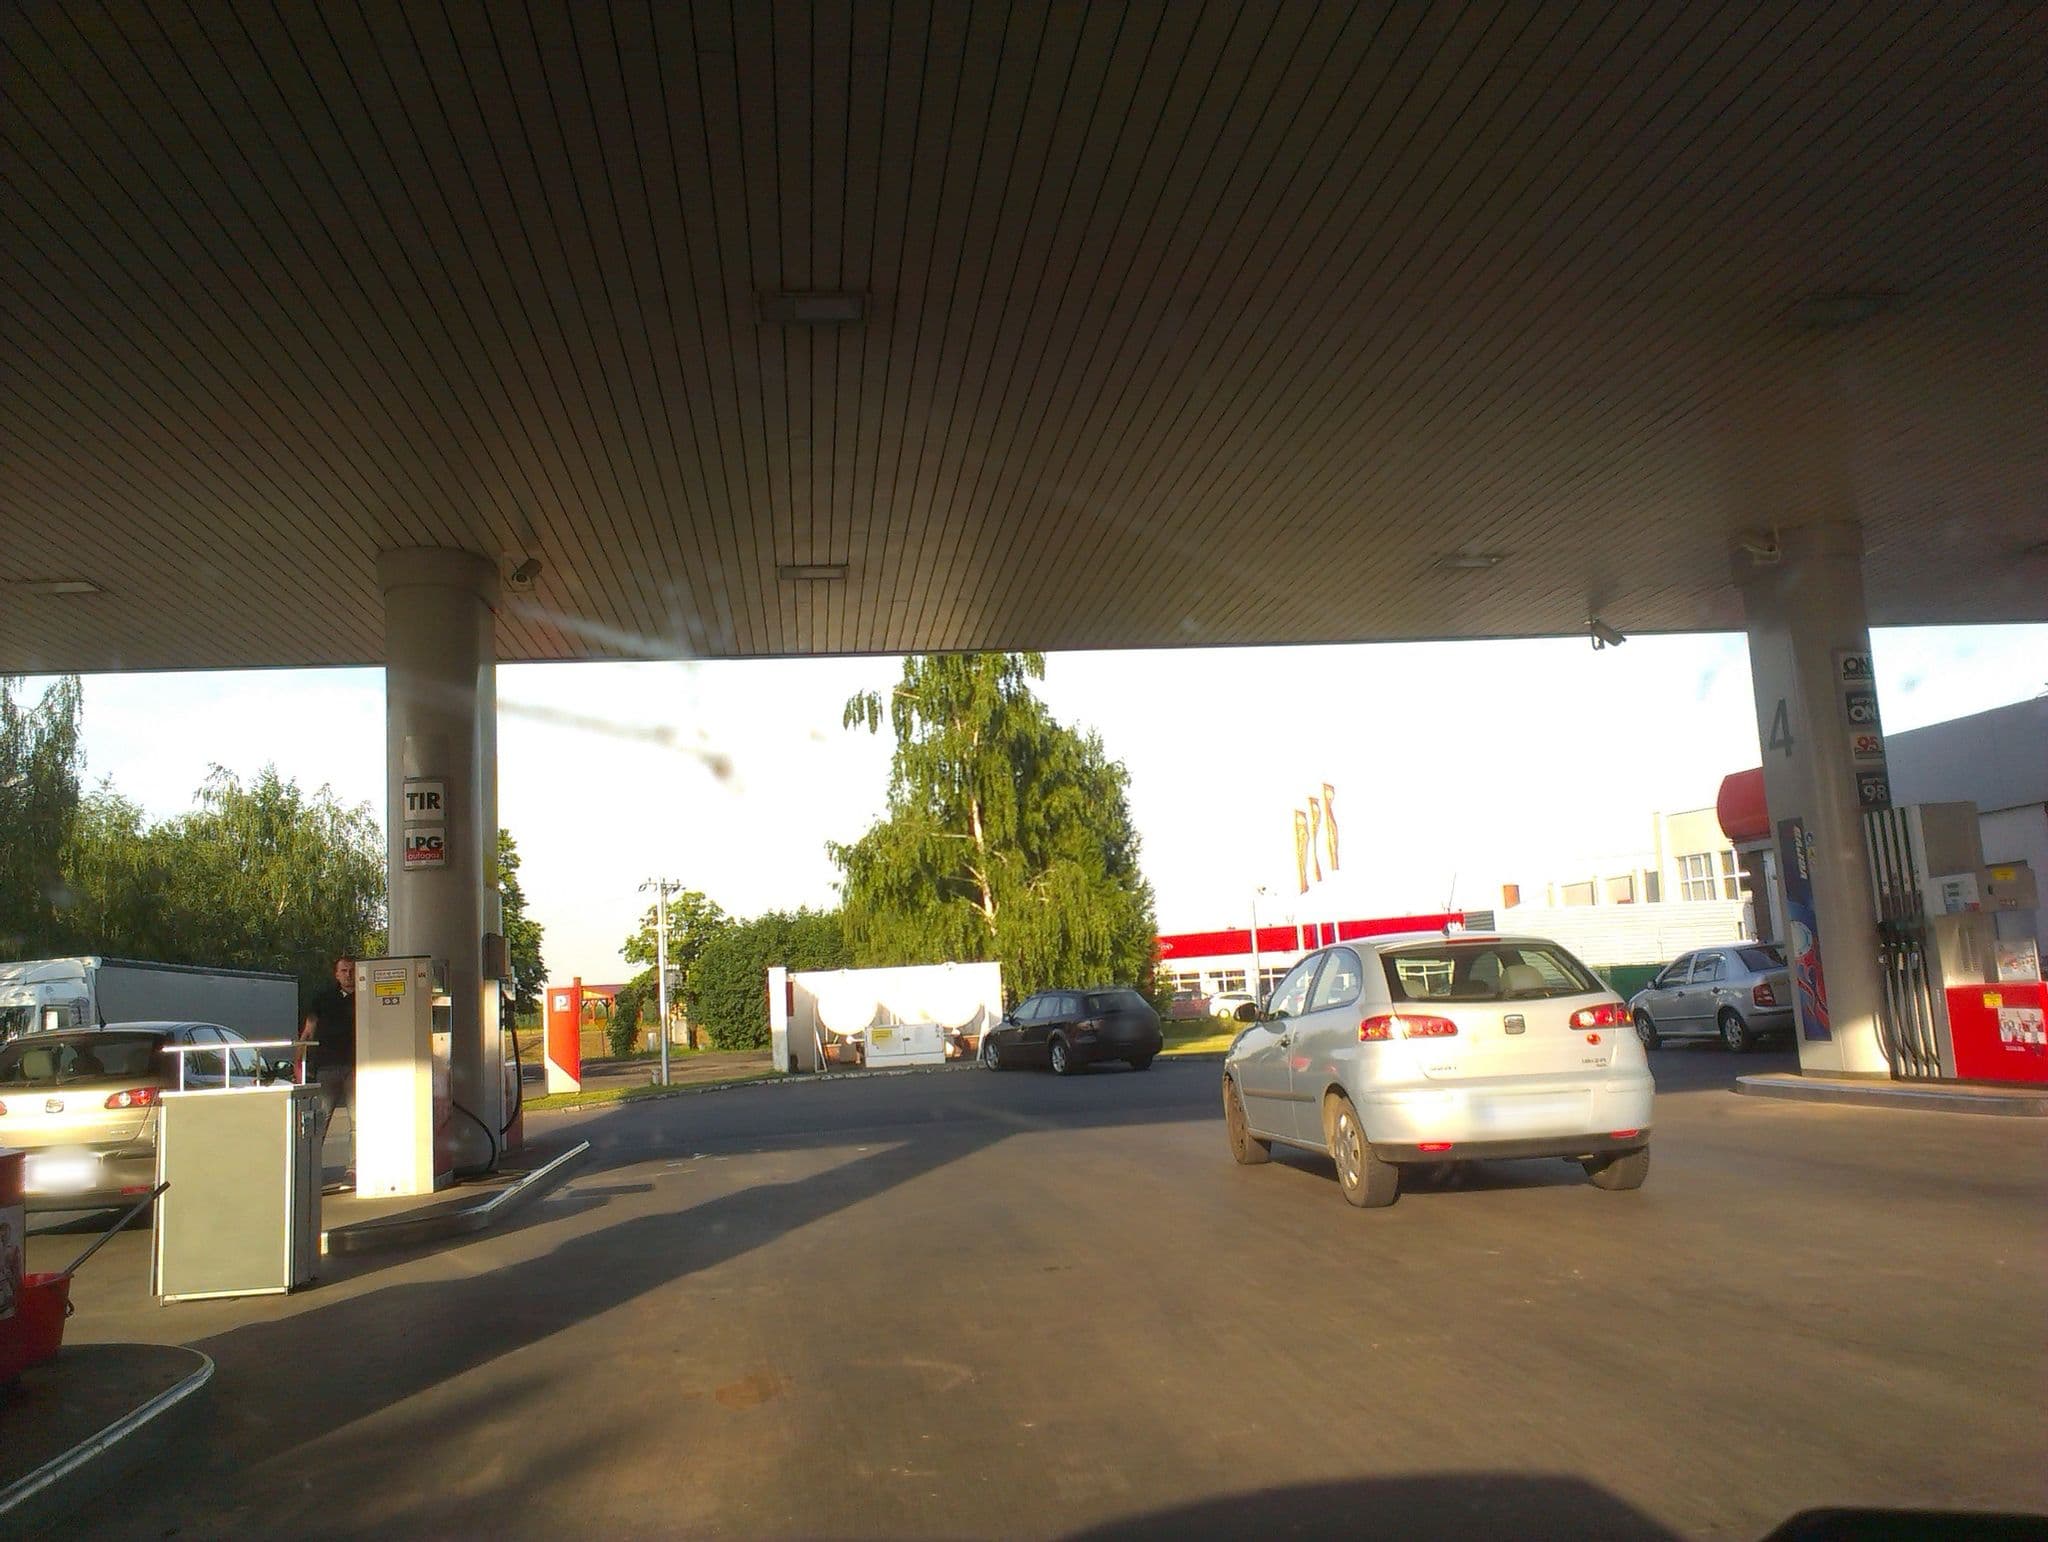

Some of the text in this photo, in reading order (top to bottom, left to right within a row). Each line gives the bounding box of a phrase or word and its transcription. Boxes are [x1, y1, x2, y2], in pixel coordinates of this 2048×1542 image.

[1843, 656, 1872, 674] ON
[1850, 704, 1877, 721] ON
[1769, 698, 1793, 757] 4
[1857, 736, 1879, 752] 95
[406, 792, 441, 811] TIR
[1863, 784, 1887, 802] 98
[406, 836, 443, 851] LPG
